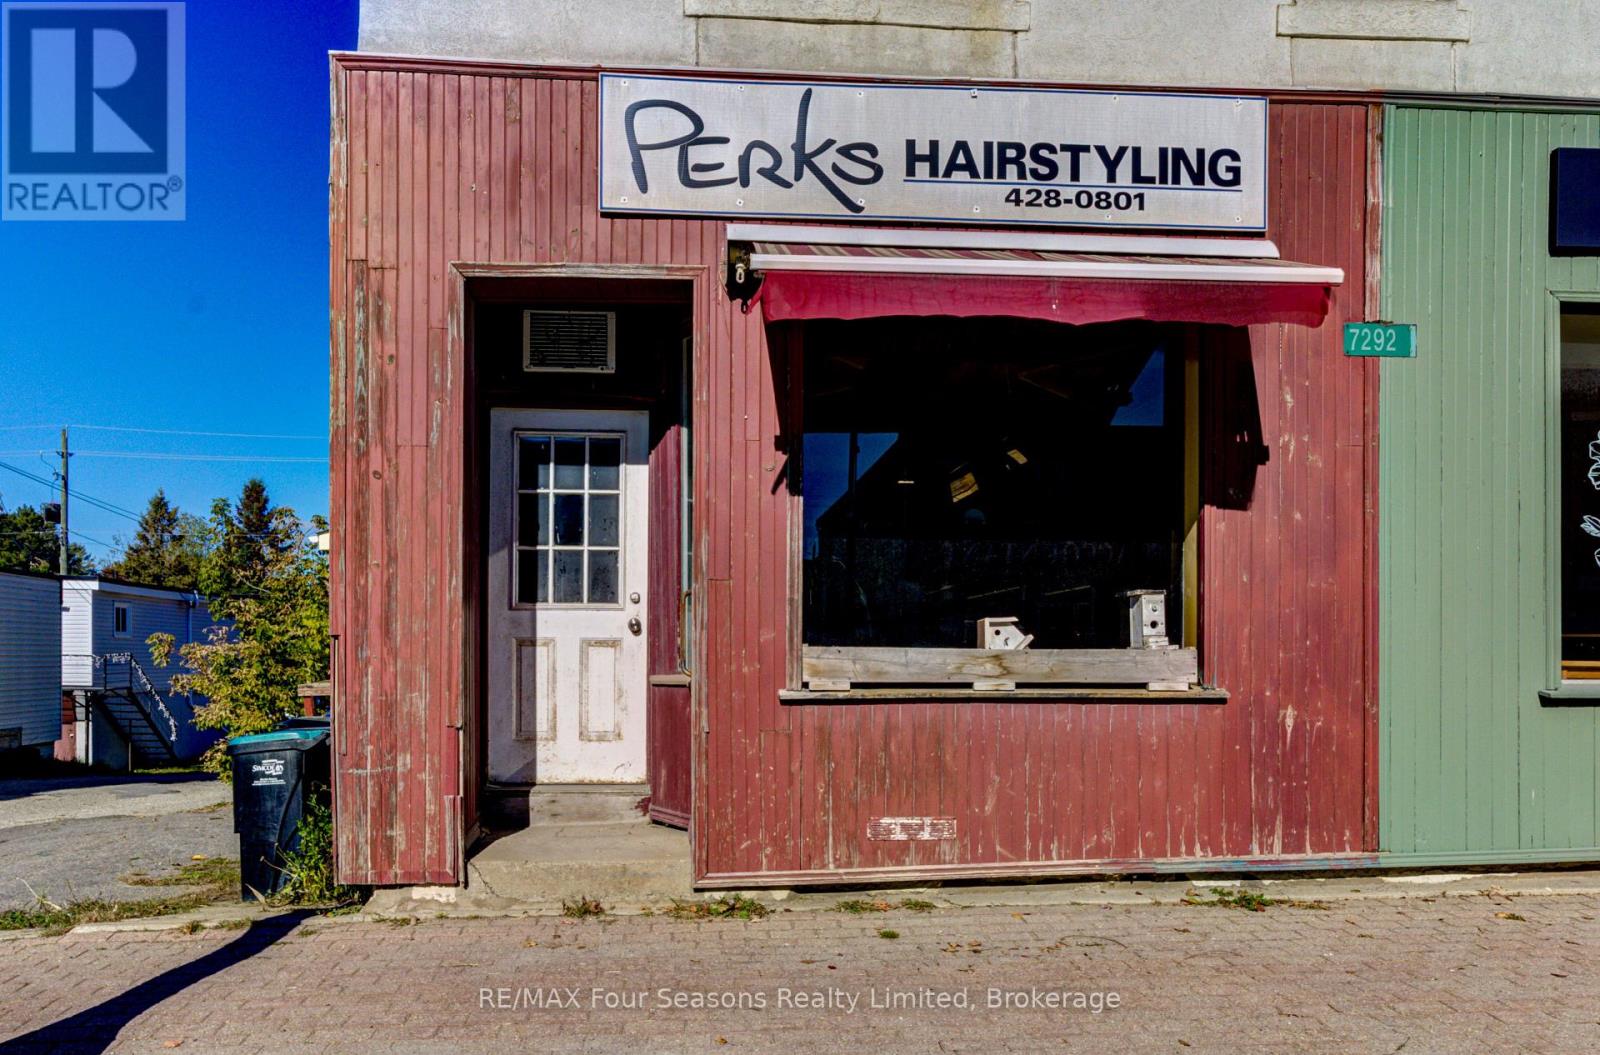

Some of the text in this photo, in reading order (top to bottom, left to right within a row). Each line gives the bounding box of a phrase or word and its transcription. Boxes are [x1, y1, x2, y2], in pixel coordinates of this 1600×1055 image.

[906, 139, 1242, 190] HAIRSTYLING
[1004, 188, 1145, 211] 428-0801
[1349, 328, 1396, 352] 7292
